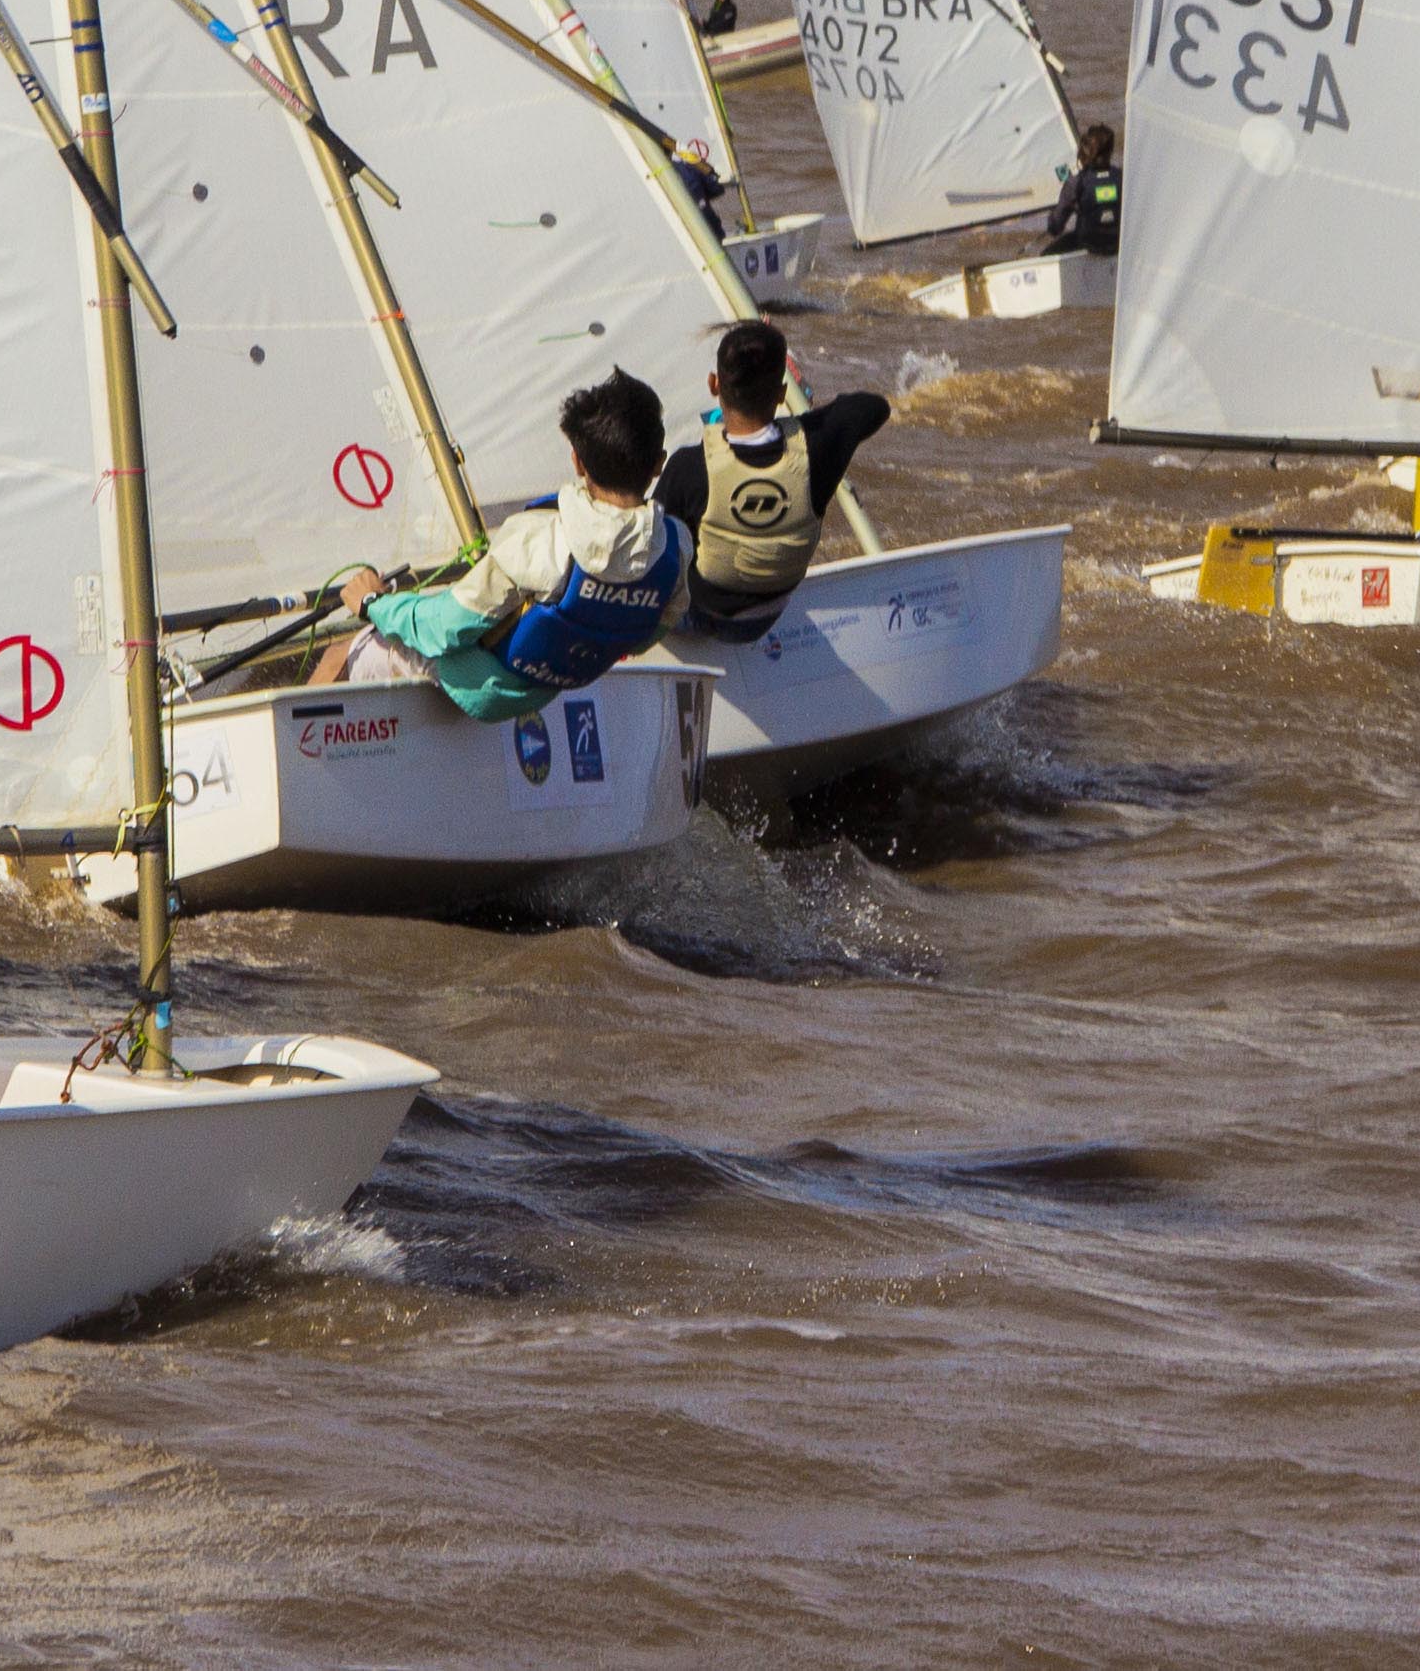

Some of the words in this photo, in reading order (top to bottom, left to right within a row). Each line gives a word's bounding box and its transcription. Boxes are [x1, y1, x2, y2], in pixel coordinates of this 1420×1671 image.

[802, 10, 900, 64] 4072
[579, 578, 661, 608] BRASIL
[324, 718, 399, 746] FAREAST
